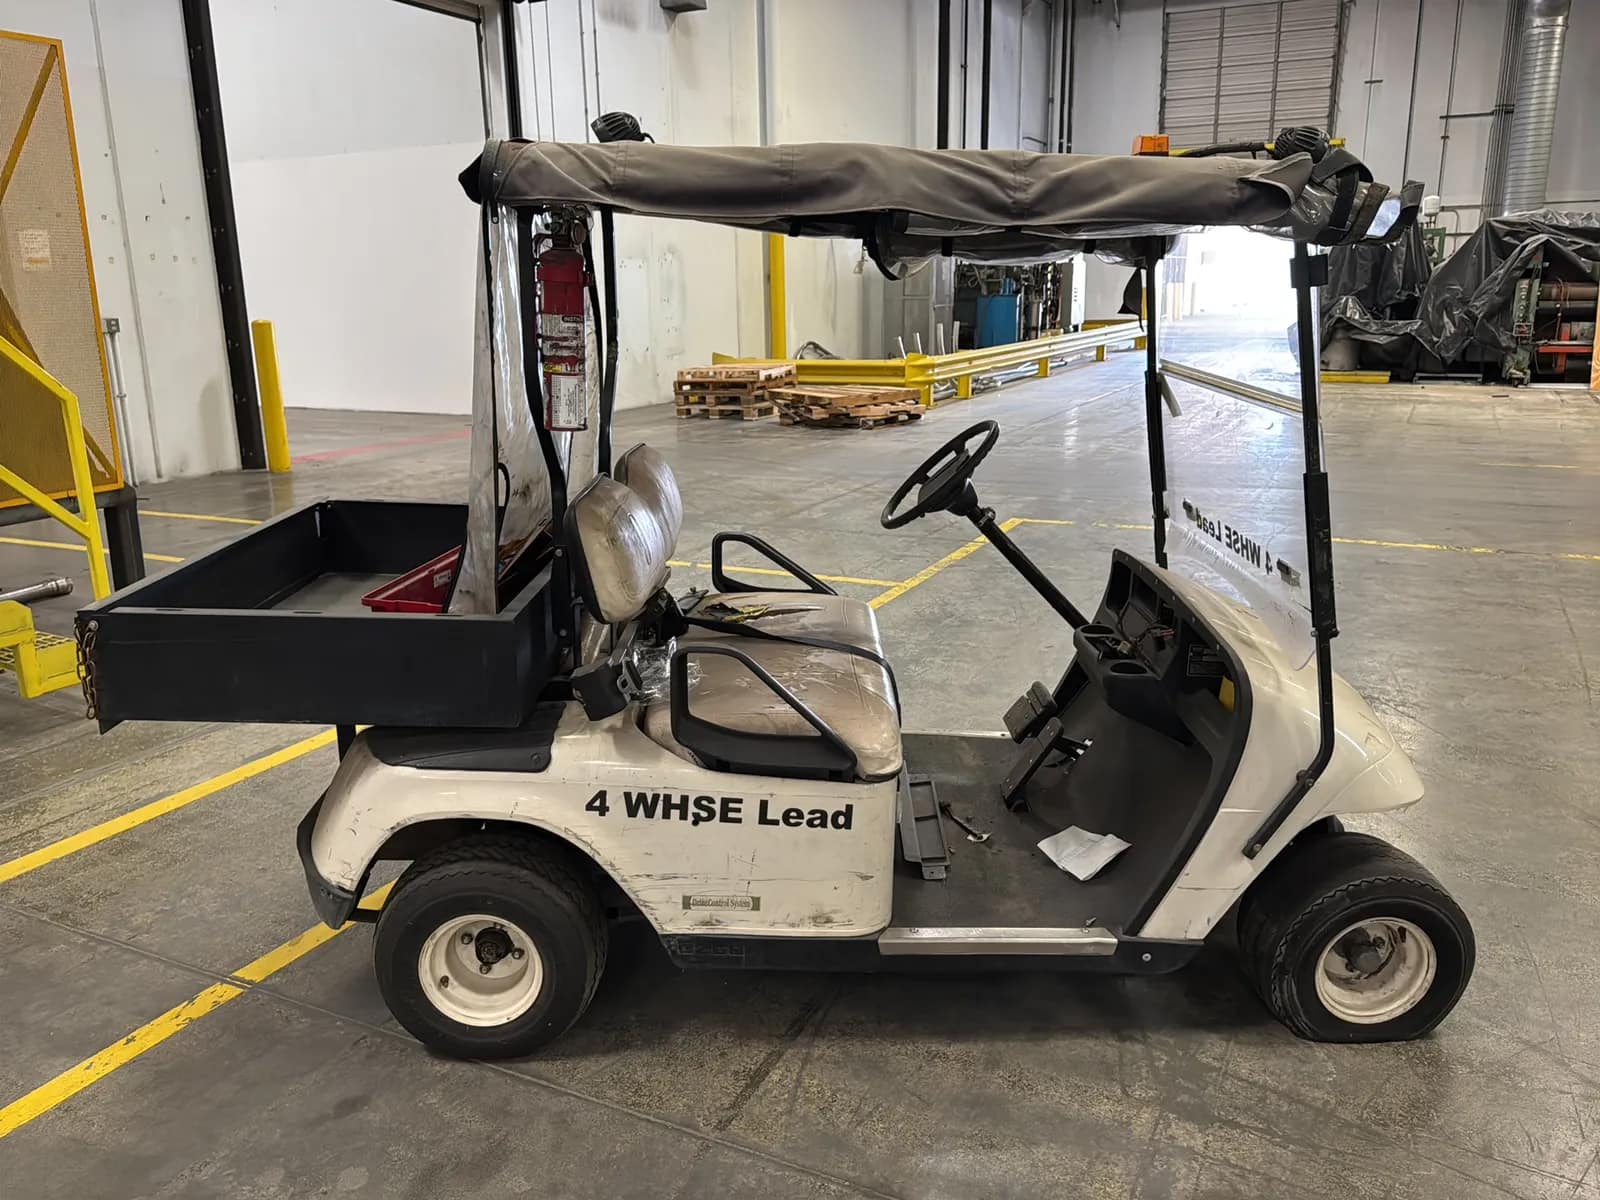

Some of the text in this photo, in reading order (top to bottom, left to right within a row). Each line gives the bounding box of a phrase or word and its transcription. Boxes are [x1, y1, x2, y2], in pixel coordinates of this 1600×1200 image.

[585, 790, 854, 830] 4 WHSE Lead
